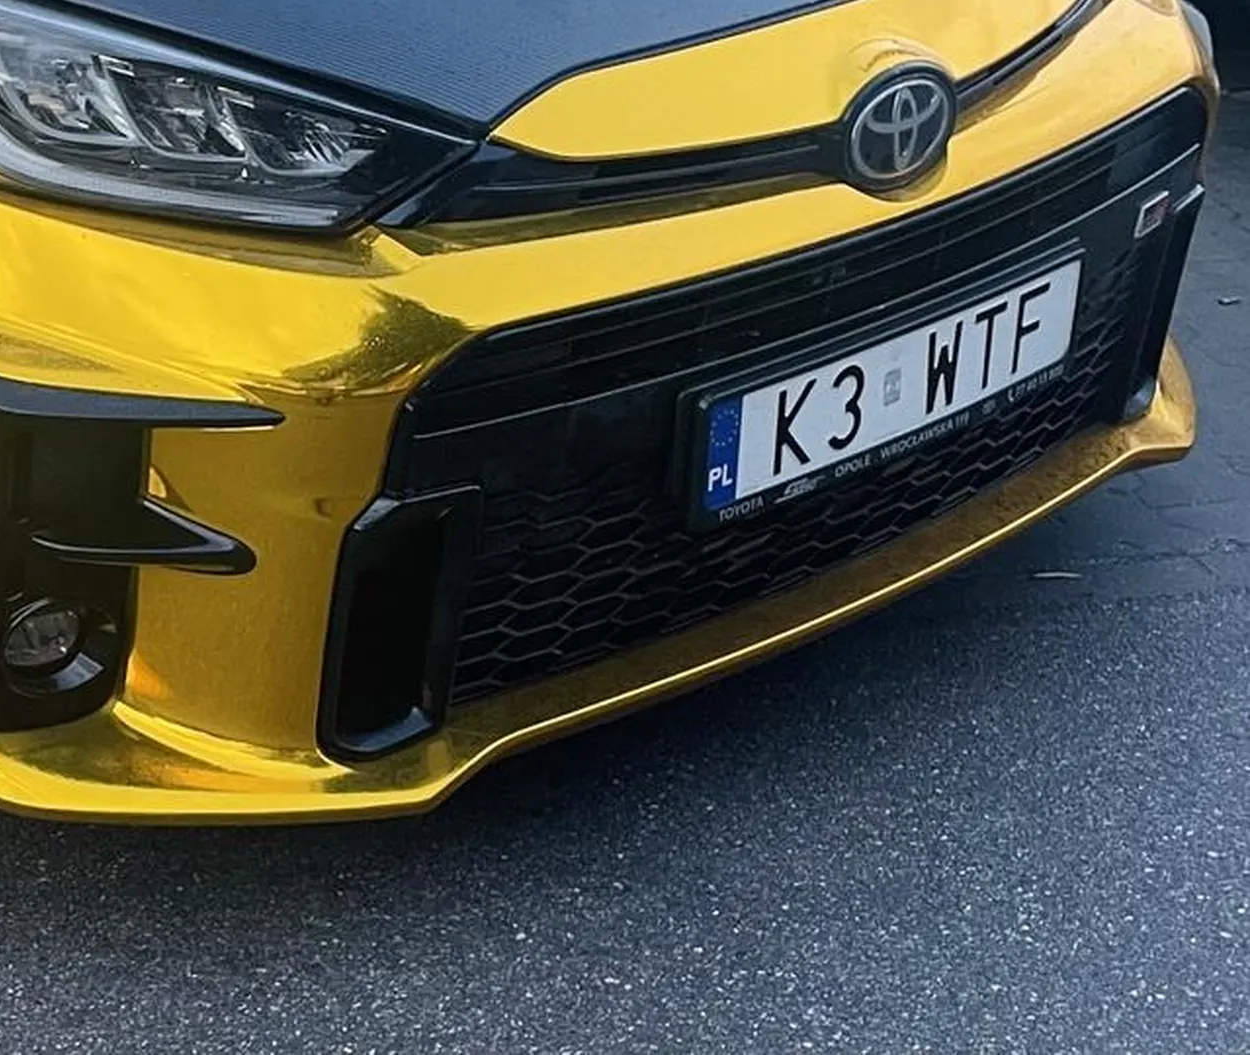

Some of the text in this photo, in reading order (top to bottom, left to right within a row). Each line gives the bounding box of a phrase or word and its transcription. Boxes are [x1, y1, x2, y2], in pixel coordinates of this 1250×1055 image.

[772, 281, 1051, 476] K3 WTF
[707, 464, 734, 493] PL
[718, 496, 765, 522] TOYOTA
[834, 455, 872, 477] OPOLE
